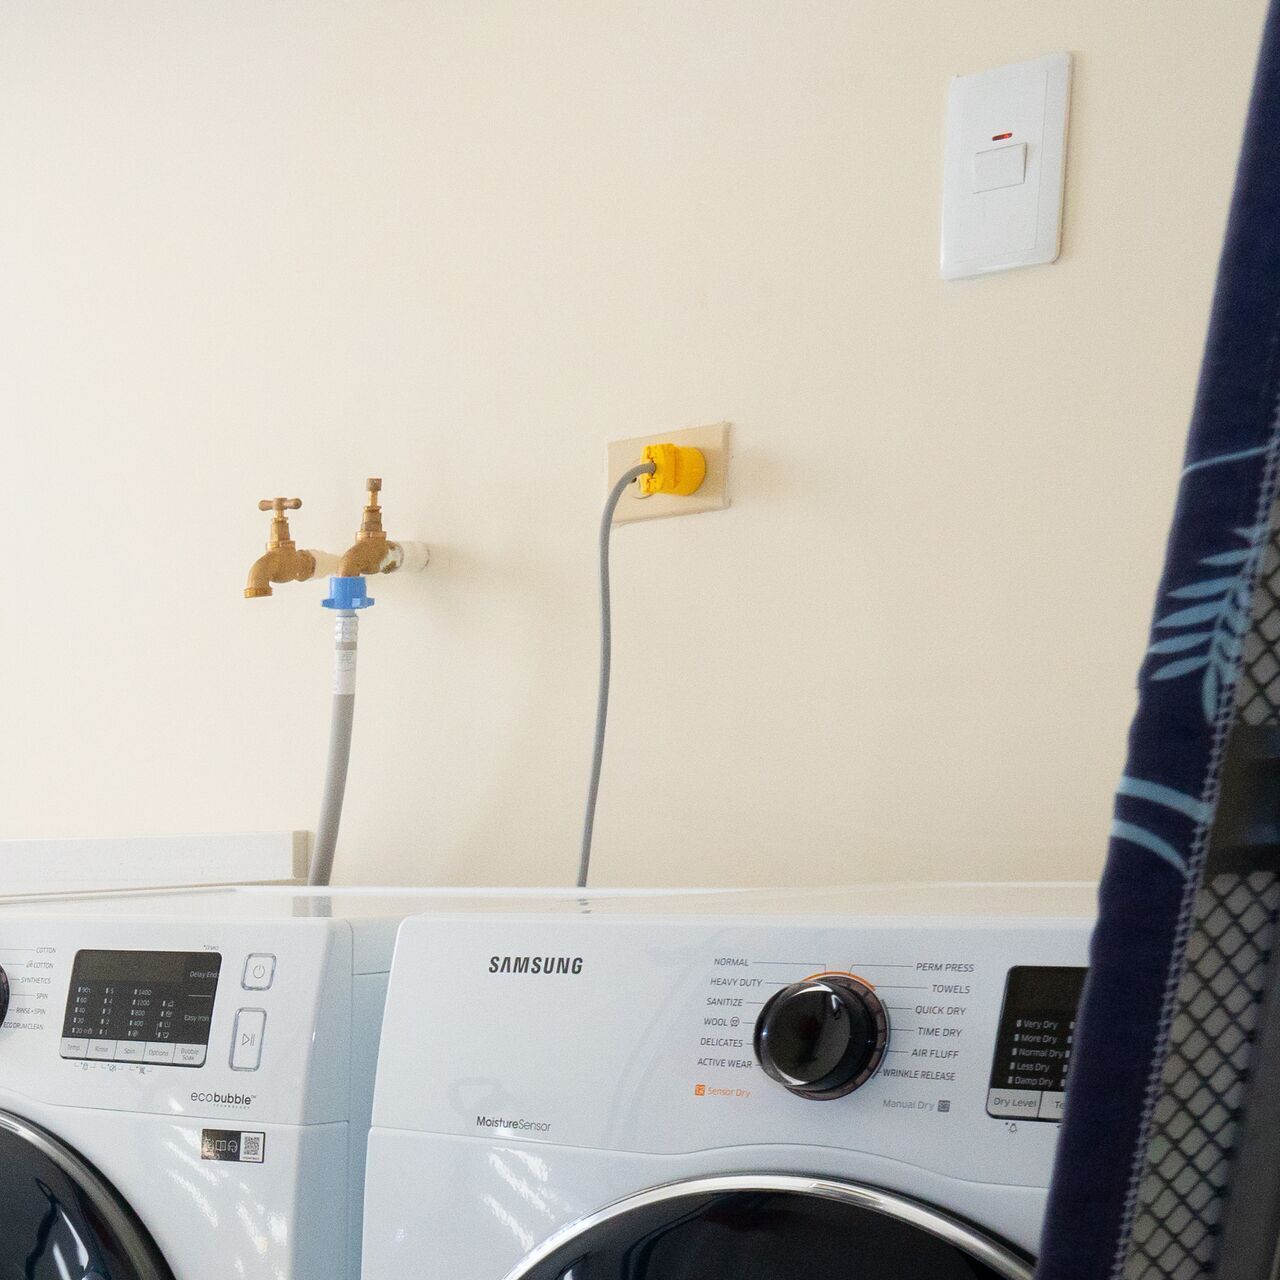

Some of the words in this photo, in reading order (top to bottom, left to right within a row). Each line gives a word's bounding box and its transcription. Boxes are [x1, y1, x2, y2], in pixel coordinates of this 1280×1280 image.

[489, 956, 583, 974] SAMSUNG
[714, 958, 749, 966] NORMAL
[916, 963, 943, 971] PERM
[945, 964, 975, 972] PRESS
[710, 978, 738, 986] HEAVY
[740, 979, 763, 987] DUTY
[933, 985, 971, 994] TOWELS
[707, 998, 744, 1007] SANITIZE
[915, 1006, 945, 1015] QUICK
[947, 1007, 967, 1016] DRY
[184, 1015, 198, 1023] Easy
[704, 1018, 728, 1027] WOOL
[1024, 1021, 1042, 1030] Very
[1043, 1021, 1059, 1030] Dry
[918, 1027, 941, 1037] TIME
[943, 1028, 963, 1038] DRY
[700, 1038, 744, 1048] DELICATES
[1022, 1035, 1041, 1043] More
[1043, 1035, 1058, 1044] Dry
[912, 1049, 928, 1057] AIR
[930, 1050, 960, 1059] FLUFF
[1019, 1049, 1047, 1057] Normal
[1049, 1050, 1065, 1059] Dry
[698, 1058, 726, 1067] ACTIVE
[728, 1060, 753, 1069] WEAR
[1017, 1063, 1034, 1071] Less
[1035, 1063, 1050, 1073] Dry
[883, 1069, 919, 1079] WRINKLE
[921, 1071, 956, 1081] RELEASE
[1015, 1077, 1038, 1087] Damp
[1039, 1078, 1054, 1087] Dry
[708, 1087, 735, 1096] Sensor
[736, 1089, 751, 1098] Dry
[883, 1100, 916, 1109] Manual
[918, 1101, 935, 1112] Dry
[994, 1098, 1010, 1107] Dry
